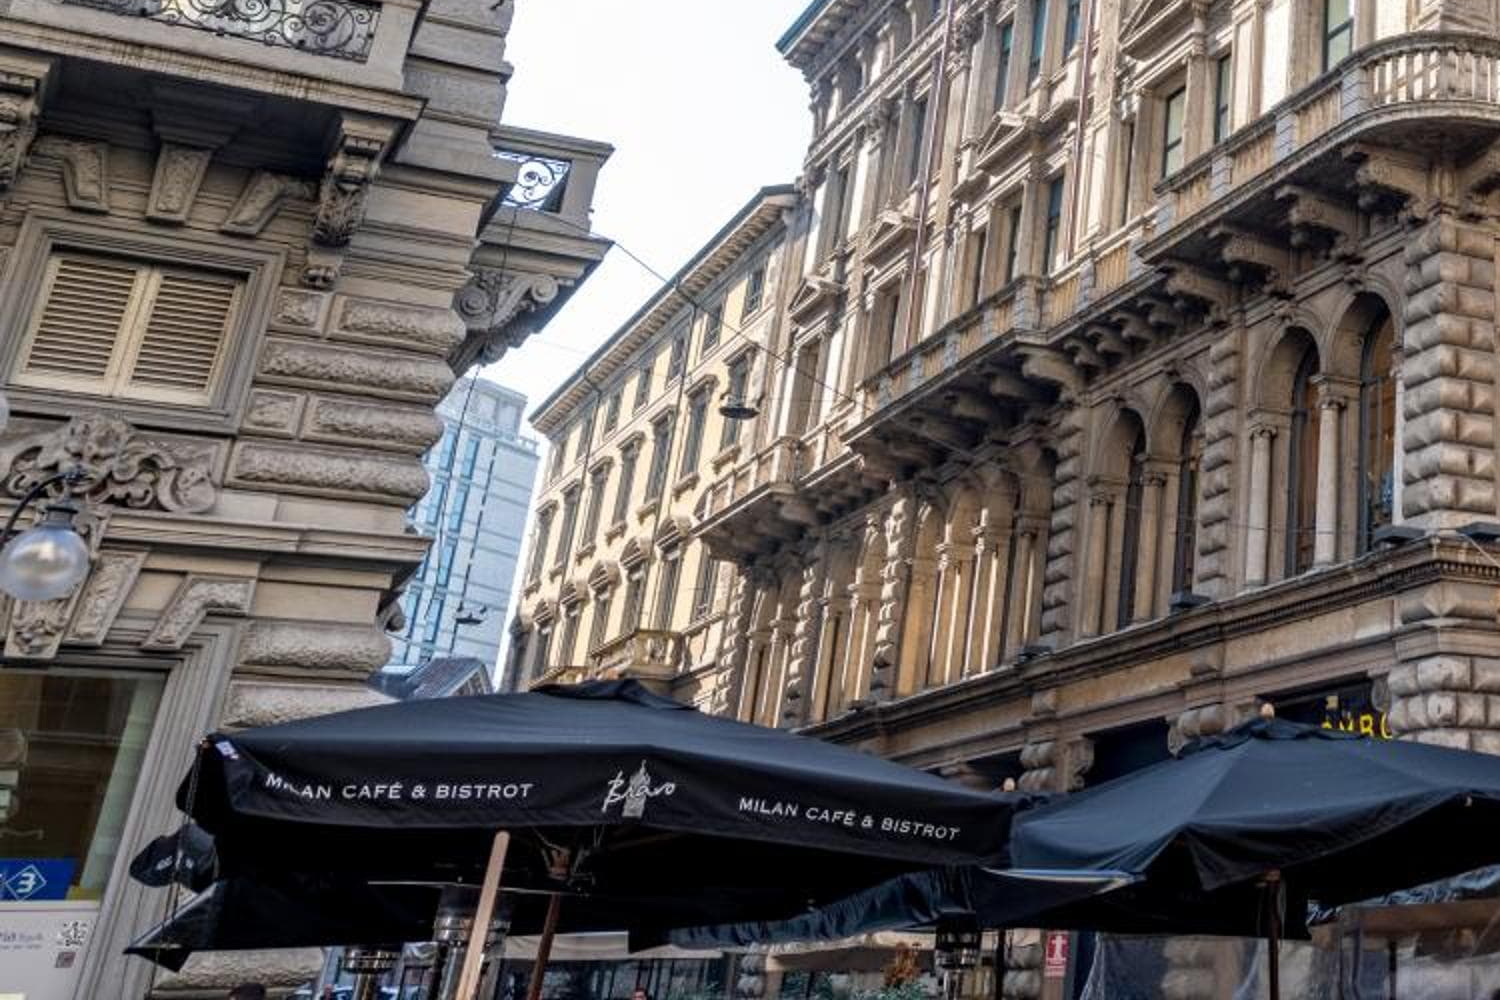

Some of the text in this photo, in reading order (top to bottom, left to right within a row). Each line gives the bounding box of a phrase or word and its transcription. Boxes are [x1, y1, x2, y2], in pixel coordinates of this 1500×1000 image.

[341, 781, 403, 800] CAFÉ
[410, 783, 427, 799] &
[434, 782, 534, 800] BISTROT
[739, 796, 799, 818] MILAN
[861, 815, 874, 829] &
[881, 816, 961, 841] BISTROT
